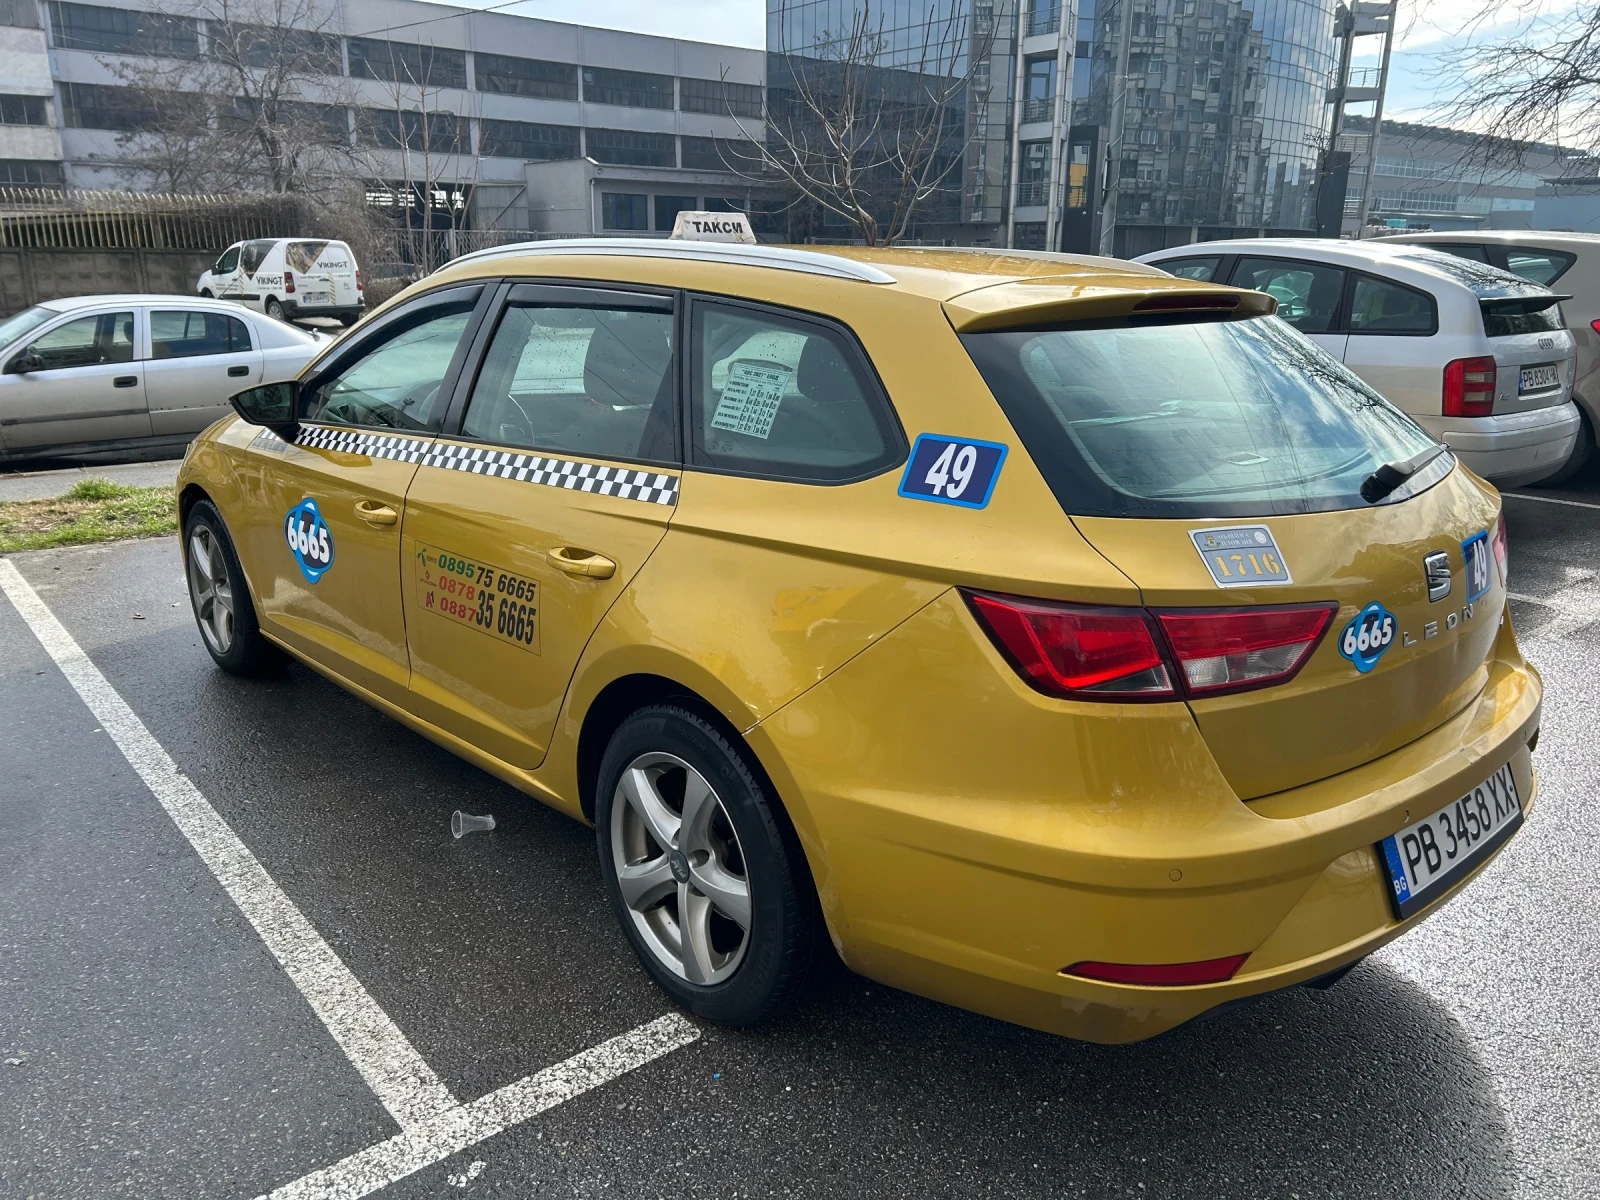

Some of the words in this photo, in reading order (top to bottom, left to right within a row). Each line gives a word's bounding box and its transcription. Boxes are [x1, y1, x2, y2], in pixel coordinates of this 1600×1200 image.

[692, 221, 743, 234] ТАКСИ
[1523, 371, 1534, 387] PB
[924, 443, 977, 499] 49
[288, 516, 330, 564] 6665
[438, 554, 475, 579] 0895
[475, 565, 494, 588] 75
[497, 574, 536, 602] 6665
[1215, 553, 1281, 577] 1716
[1473, 539, 1488, 592] 49
[438, 575, 476, 601] 0878
[440, 597, 477, 622] 0887
[476, 590, 495, 629] 35
[497, 598, 536, 645] 6665
[1343, 617, 1392, 655] 6665
[1402, 603, 1474, 648] LEON
[680, 729, 708, 752] OUTSIDE
[1401, 823, 1442, 886] PB
[1438, 787, 1491, 860] 3458
[1486, 767, 1516, 823] XX
[1393, 876, 1408, 895] BG
